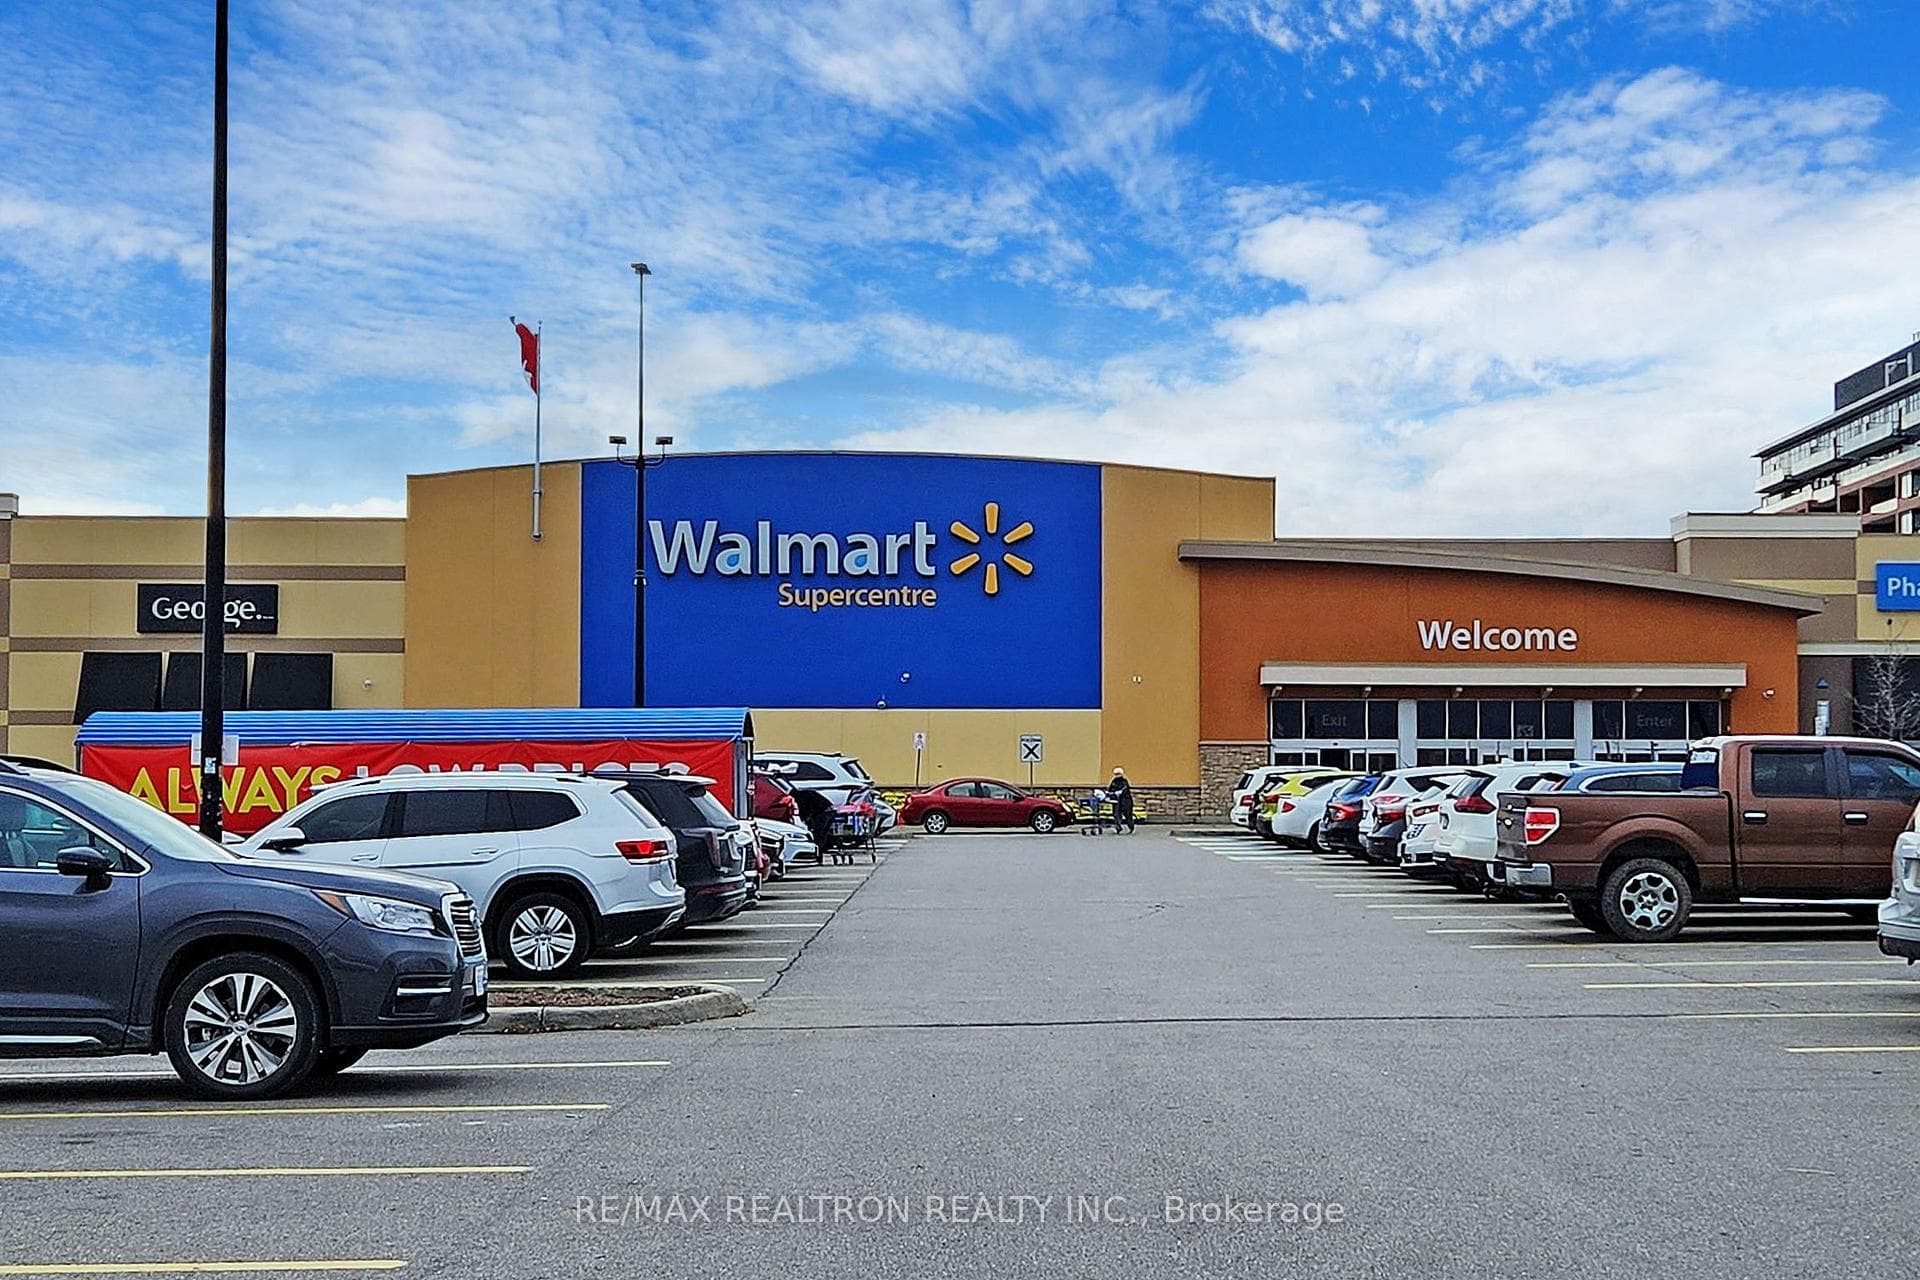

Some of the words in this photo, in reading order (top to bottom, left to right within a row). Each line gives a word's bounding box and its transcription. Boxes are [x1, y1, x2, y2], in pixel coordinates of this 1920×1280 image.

[648, 520, 936, 576] Walmart
[151, 597, 262, 628] Geoge.
[778, 583, 937, 612] Supercentre
[1417, 620, 1578, 651] Welcome
[1322, 714, 1347, 727] Exit
[1637, 714, 1673, 727] Enter
